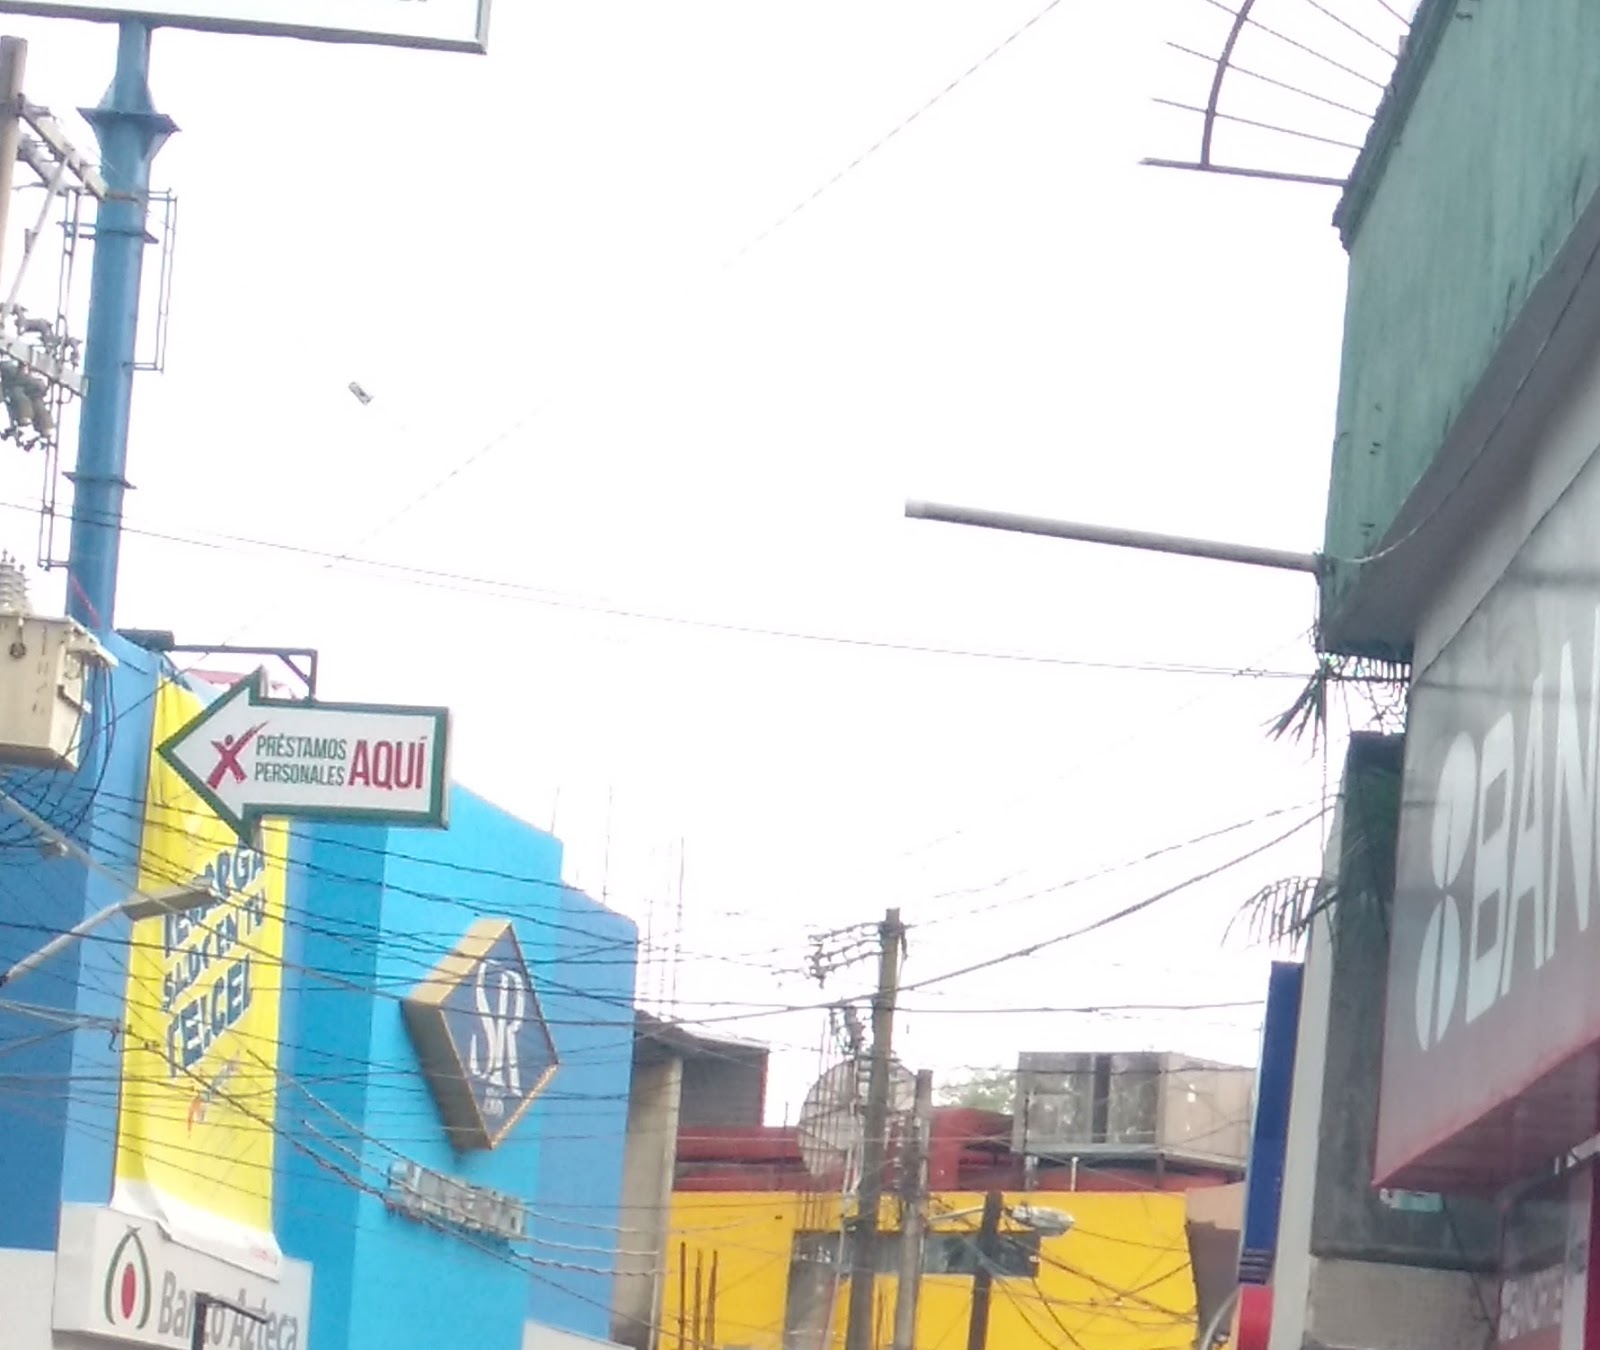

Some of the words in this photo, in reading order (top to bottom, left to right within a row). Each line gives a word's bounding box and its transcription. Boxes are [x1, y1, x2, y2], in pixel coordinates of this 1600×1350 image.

[255, 762, 345, 787] PERSONALES
[349, 736, 427, 791] AQUÍ
[158, 1269, 226, 1345] Bao
